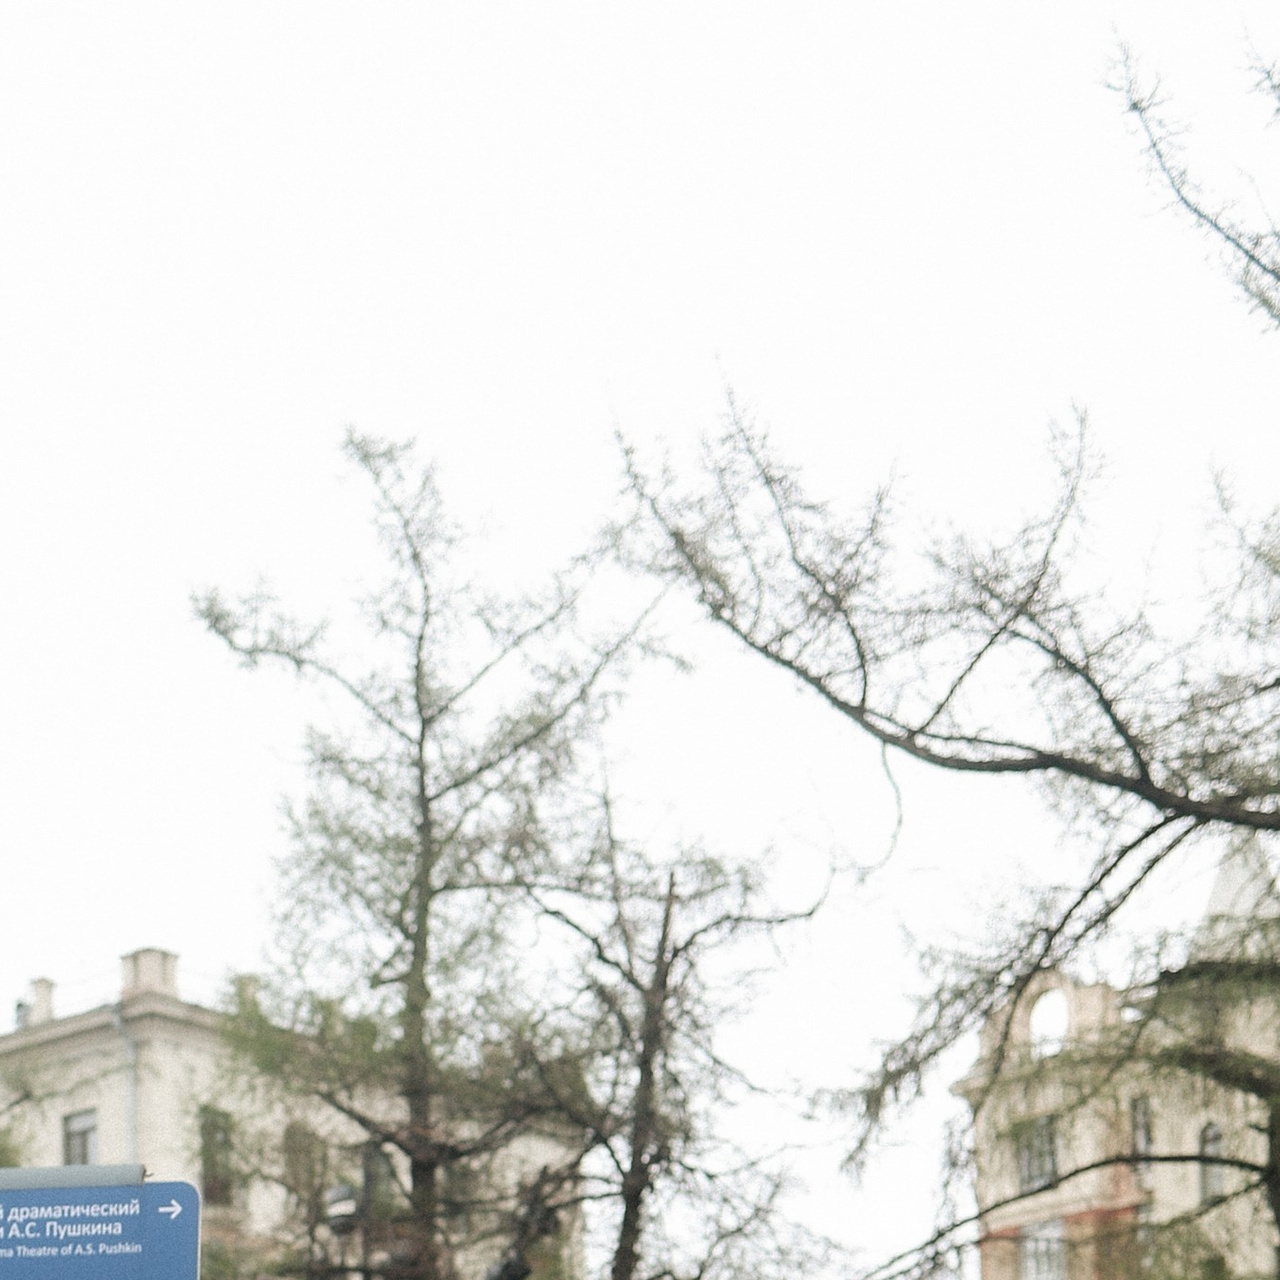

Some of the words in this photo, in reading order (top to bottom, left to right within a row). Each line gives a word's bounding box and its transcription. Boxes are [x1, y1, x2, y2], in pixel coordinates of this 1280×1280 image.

[6, 1198, 141, 1222] драматический
[7, 1221, 41, 1239] А.С.
[45, 1220, 123, 1240] Пушкина
[16, 1244, 59, 1257] Theatre
[60, 1243, 73, 1256] of
[74, 1243, 96, 1256] A.S.
[98, 1241, 142, 1255] Pushkin
